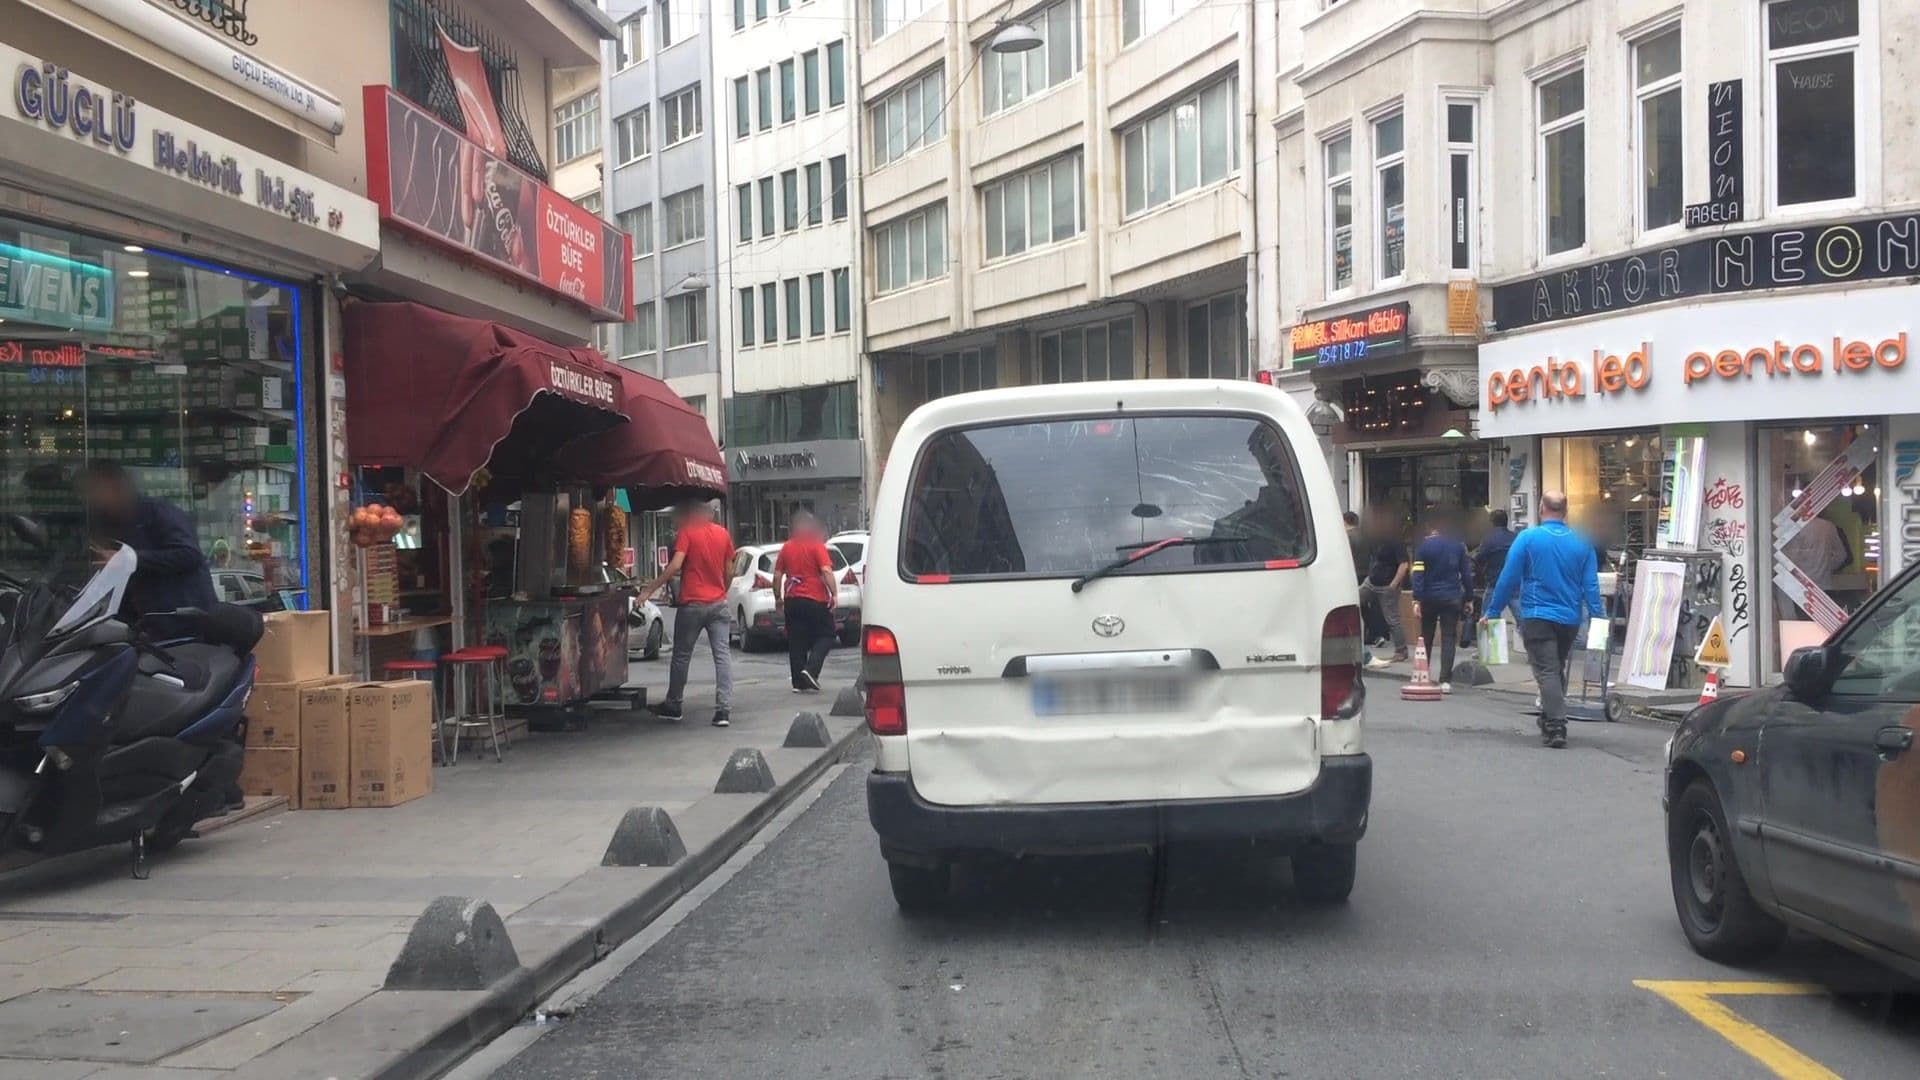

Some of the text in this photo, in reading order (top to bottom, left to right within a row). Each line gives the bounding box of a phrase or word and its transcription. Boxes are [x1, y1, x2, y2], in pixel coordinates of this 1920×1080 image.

[1775, 5, 1847, 36] NEON
[1712, 81, 1735, 199] NEON
[546, 203, 596, 253] ÖZTÜRKLER
[1685, 201, 1738, 225] TABELA
[561, 241, 583, 273] BÜFE
[1532, 248, 1681, 321] AKKOR
[1714, 217, 1919, 288] NEON
[550, 360, 614, 403] ÖZTÜRKLER BÜFE
[1487, 341, 1651, 412] penta led
[1684, 331, 1907, 385] penta led
